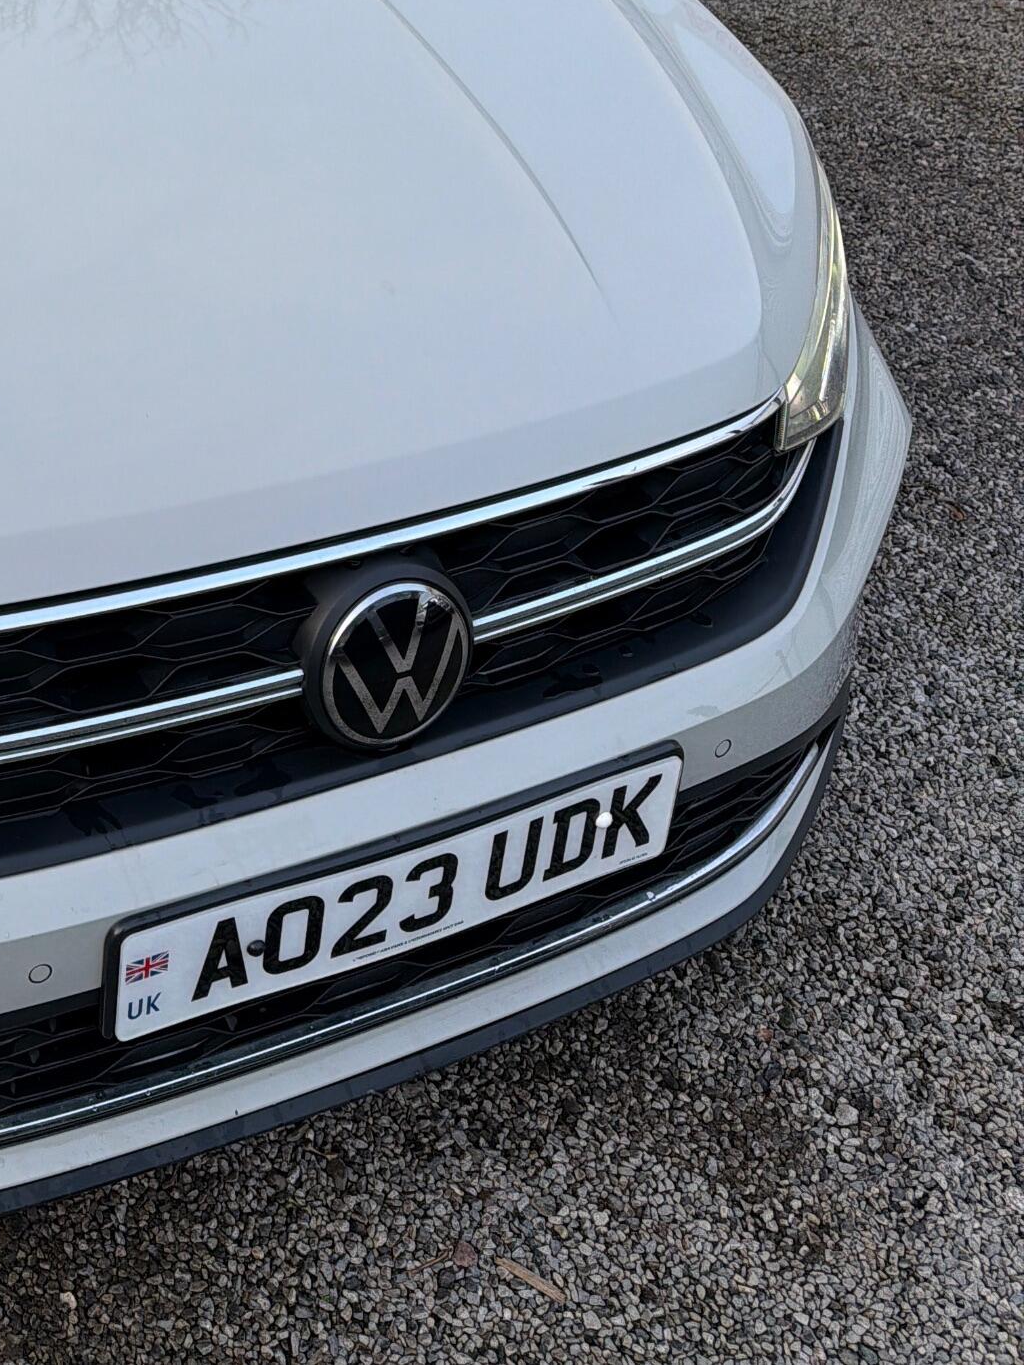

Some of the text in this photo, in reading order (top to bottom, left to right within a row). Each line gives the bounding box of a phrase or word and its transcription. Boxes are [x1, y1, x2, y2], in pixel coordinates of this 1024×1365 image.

[191, 773, 664, 1003] AO23 UDK
[127, 992, 161, 1021] UK
